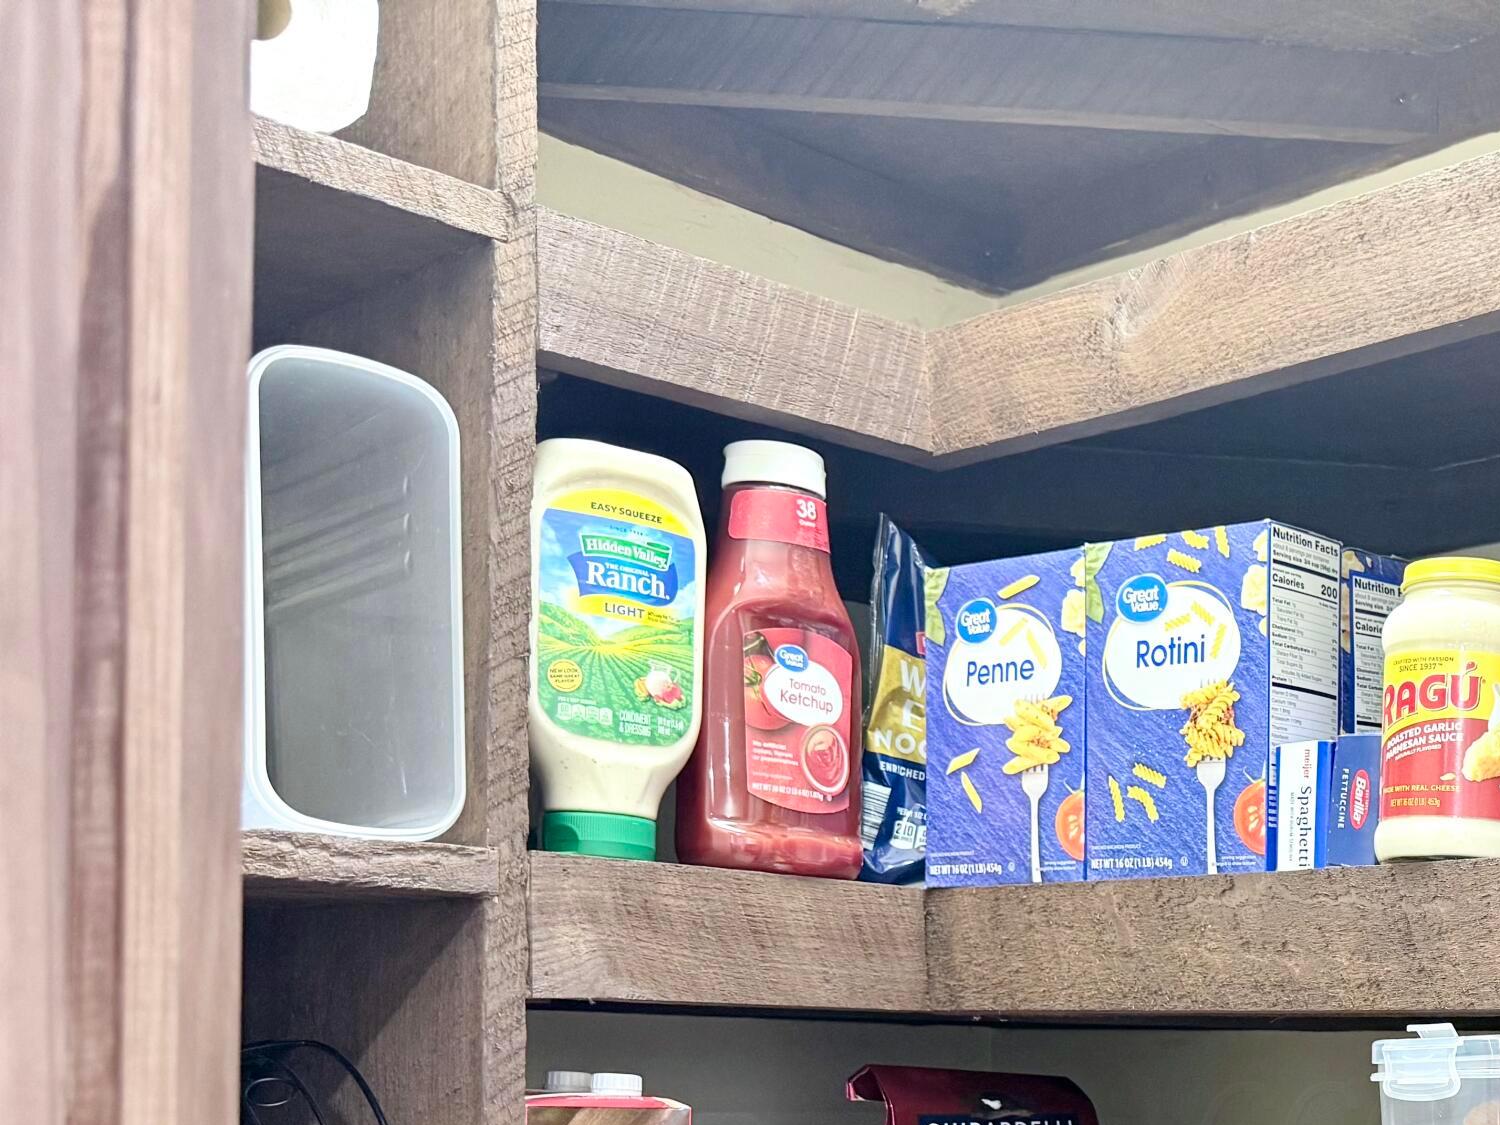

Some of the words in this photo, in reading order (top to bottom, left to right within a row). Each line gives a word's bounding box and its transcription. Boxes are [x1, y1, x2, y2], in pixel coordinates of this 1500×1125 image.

[591, 501, 617, 515] EASY
[619, 507, 663, 524] SQUEEZE
[796, 499, 817, 520] 38
[586, 538, 632, 557] Hidden
[1273, 527, 1312, 549] Nutrition
[1316, 542, 1338, 557] Facts
[606, 562, 619, 571] THE
[620, 565, 650, 577] ORIGINAL
[1122, 588, 1160, 603] Great
[1272, 573, 1305, 590] Calories
[1321, 584, 1338, 599] 200
[1354, 578, 1396, 597] Nutrition
[605, 602, 645, 619] LIGHT
[1131, 599, 1160, 613] Value
[961, 609, 991, 627] Great
[1355, 621, 1382, 634] Calori
[967, 624, 991, 636] Value
[780, 650, 804, 663] Great
[1136, 634, 1205, 668] Rotini
[966, 659, 1034, 687] Penne
[1399, 663, 1418, 673] SINCE
[1419, 662, 1437, 672] 1937
[789, 678, 826, 696] Tomato
[780, 688, 834, 714] Ketchup
[1387, 727, 1422, 750] ROASTED
[1423, 721, 1463, 735] GARLIC
[1386, 738, 1427, 761] PARMESAN
[1428, 732, 1464, 745] SAUCE
[1416, 743, 1441, 753] FLAVORED
[880, 760, 925, 781] ENRICHED
[1302, 749, 1312, 779] meijer
[1337, 768, 1350, 829] FETTUCCINE
[1395, 785, 1411, 793] WITH
[1412, 785, 1429, 793] REAL
[1431, 785, 1461, 793] CHEESE
[1353, 776, 1367, 825] Barilla
[1296, 786, 1312, 867] Spaghetti
[1115, 858, 1124, 869] 16
[1155, 857, 1173, 870] 454g
